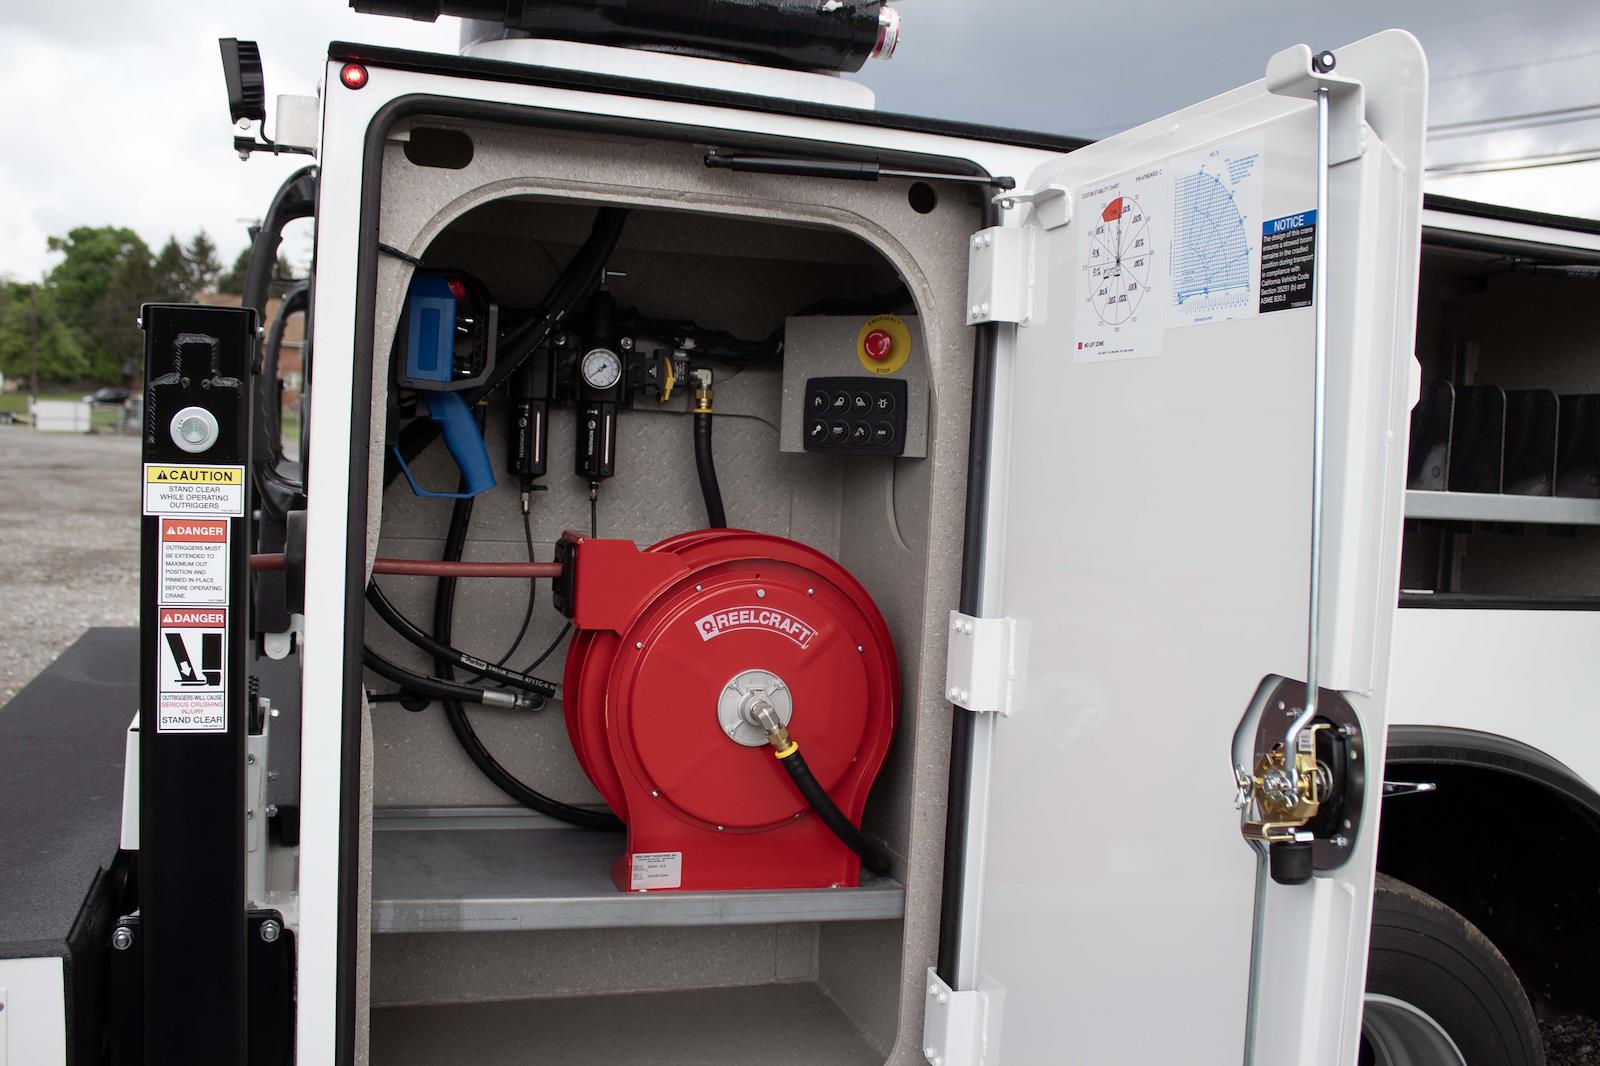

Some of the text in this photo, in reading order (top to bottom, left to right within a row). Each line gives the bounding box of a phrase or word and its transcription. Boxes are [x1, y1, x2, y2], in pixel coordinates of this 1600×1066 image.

[1274, 215, 1304, 231] NOTICE
[1300, 236, 1312, 244] boom
[1292, 245, 1308, 254] cradled
[1262, 254, 1313, 270] position during transport
[1266, 268, 1290, 277] compliance
[1261, 279, 1281, 287] California
[1281, 275, 1297, 284] Vehicle
[1261, 288, 1276, 296] Section
[1297, 282, 1306, 290] and
[1261, 294, 1286, 304] ASME B30.5
[868, 316, 901, 326] EMERGENCY
[170, 470, 232, 481] CAUTION
[177, 526, 223, 535] DANGER
[174, 614, 224, 623] DANGER
[716, 610, 811, 641] REELCRAFT
[465, 656, 486, 670] Parker
[162, 716, 222, 724] STAND CLEAR
